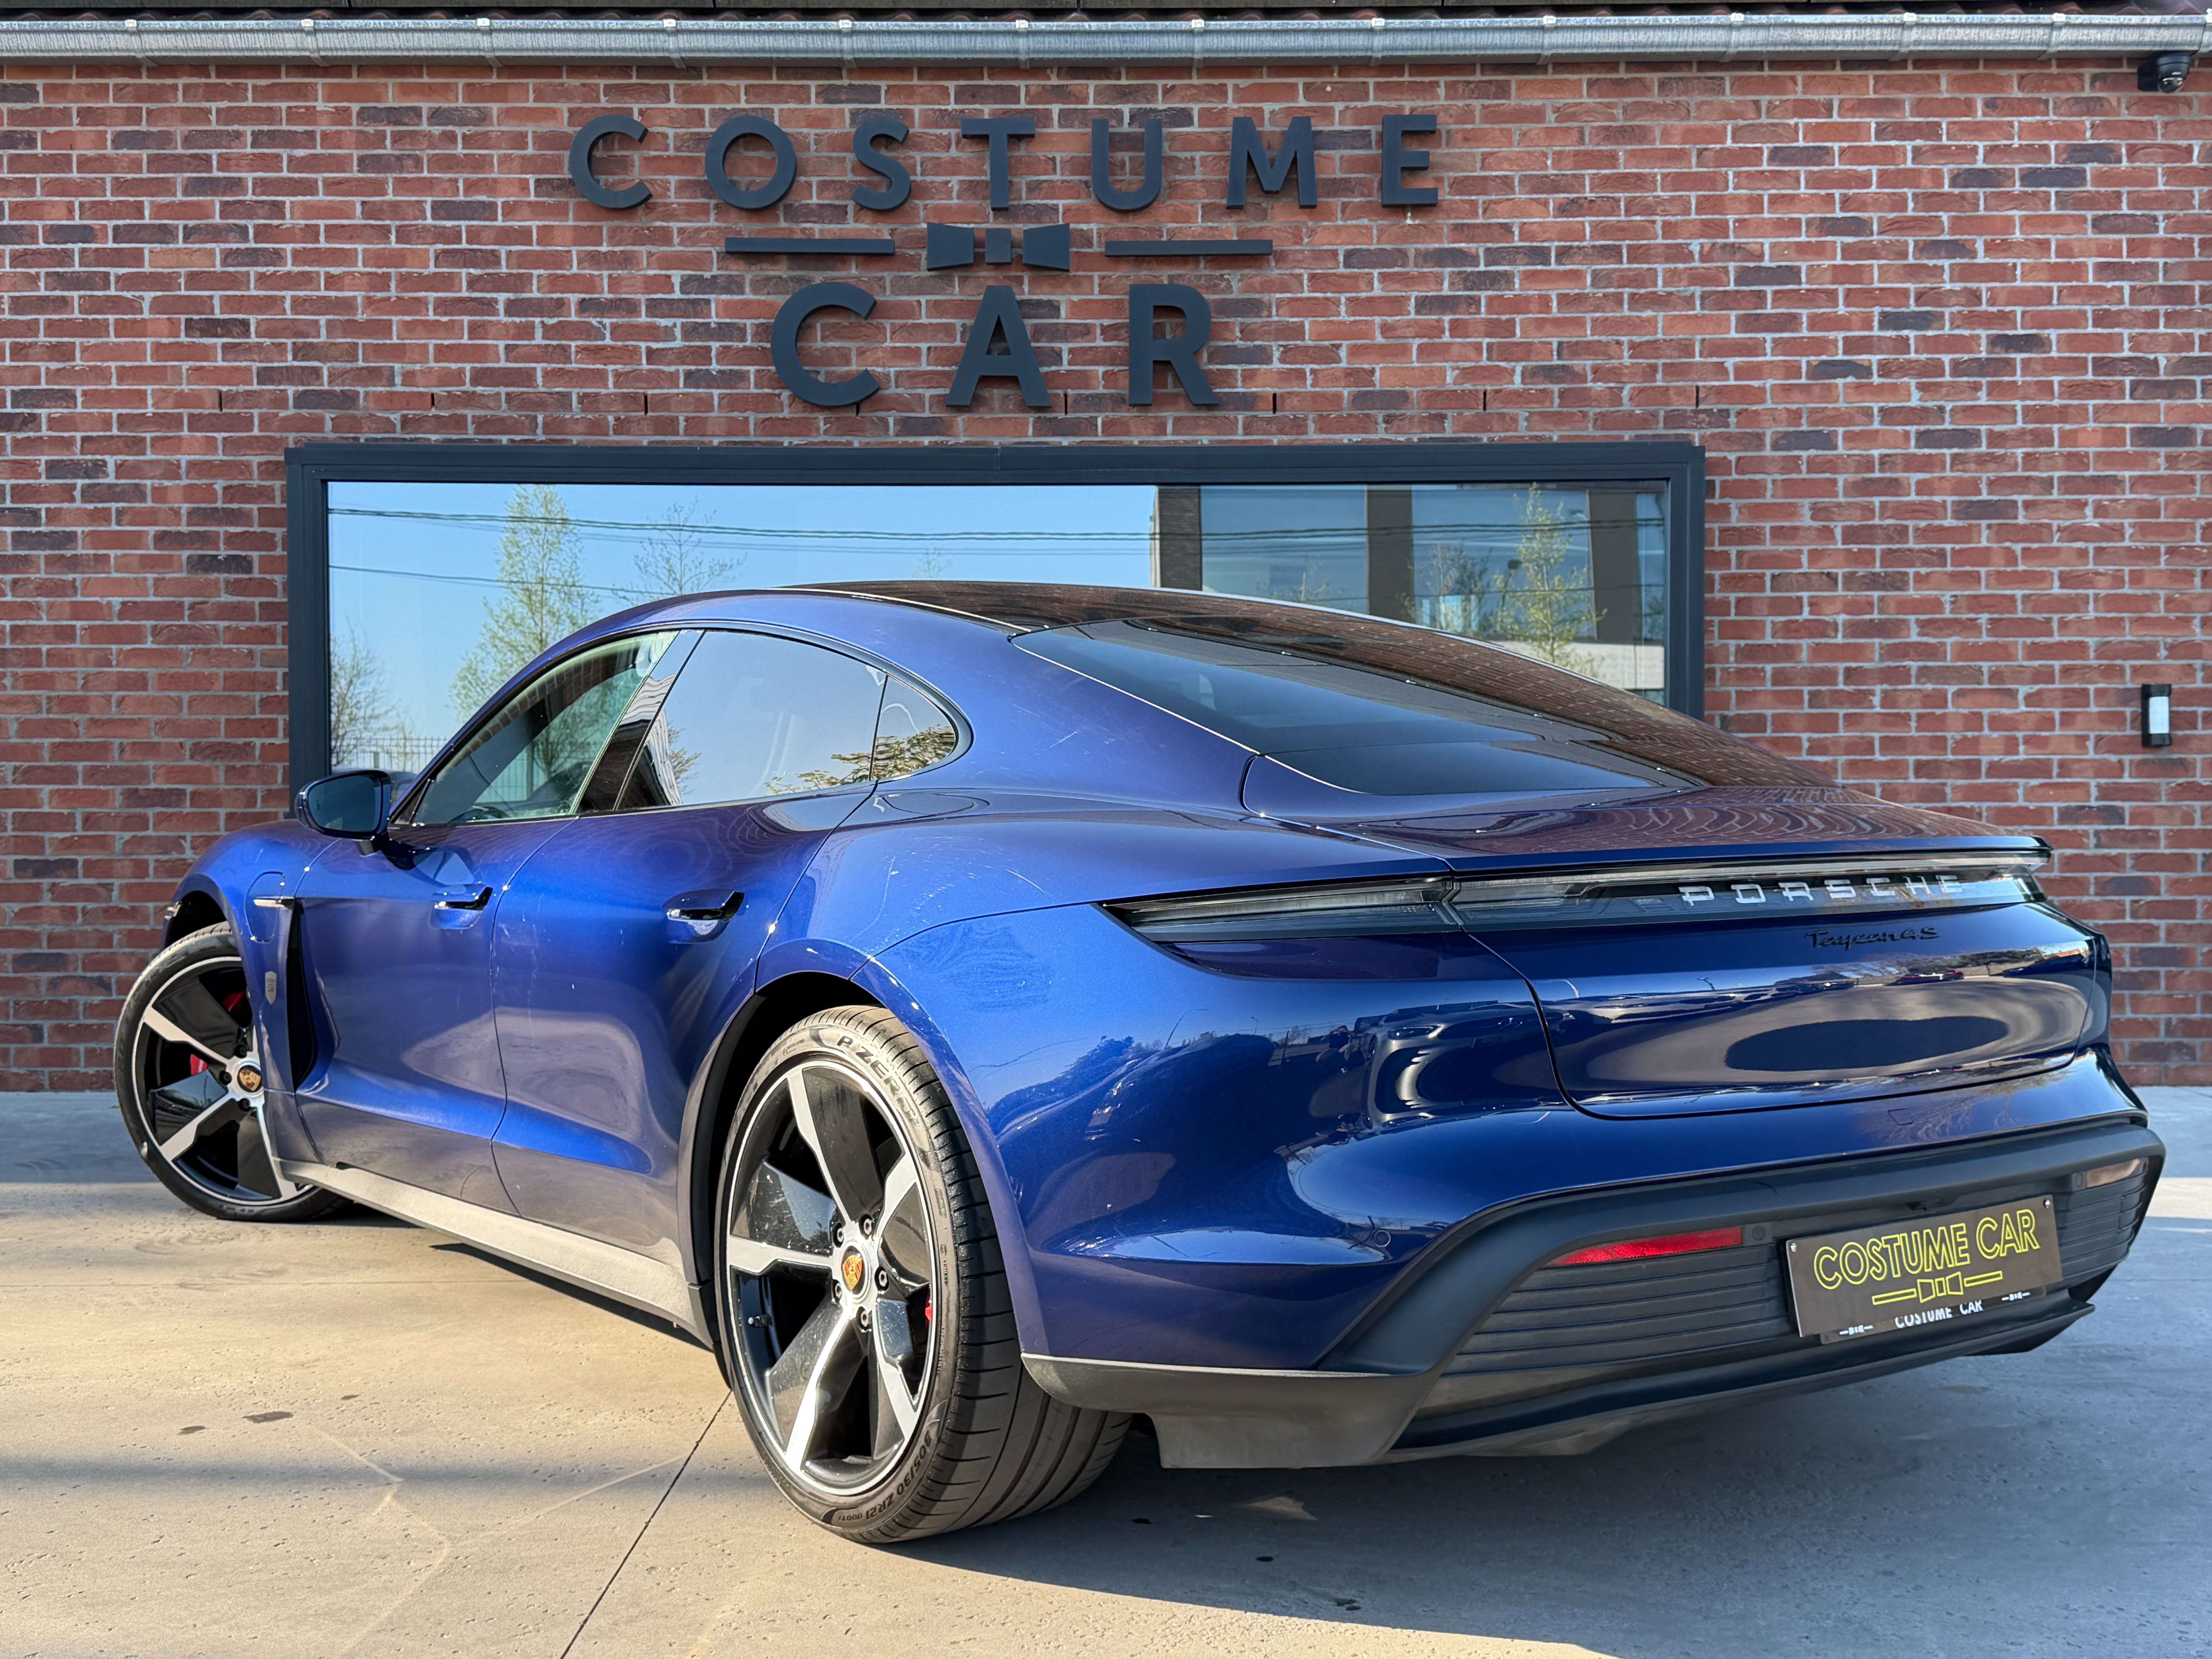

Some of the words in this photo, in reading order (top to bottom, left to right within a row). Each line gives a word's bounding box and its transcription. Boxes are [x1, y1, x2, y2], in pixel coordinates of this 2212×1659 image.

[569, 113, 1439, 213] COSTUME
[771, 282, 1219, 409] CAR
[1678, 874, 1963, 906] PORSCHE
[1804, 930, 1901, 951] Taycan
[836, 1035, 854, 1047] P
[1814, 1223, 1970, 1290] COSTUME
[1976, 1209, 2040, 1259] CAR
[896, 1430, 932, 1495] 305/30
[865, 1492, 895, 1520] ZR21
